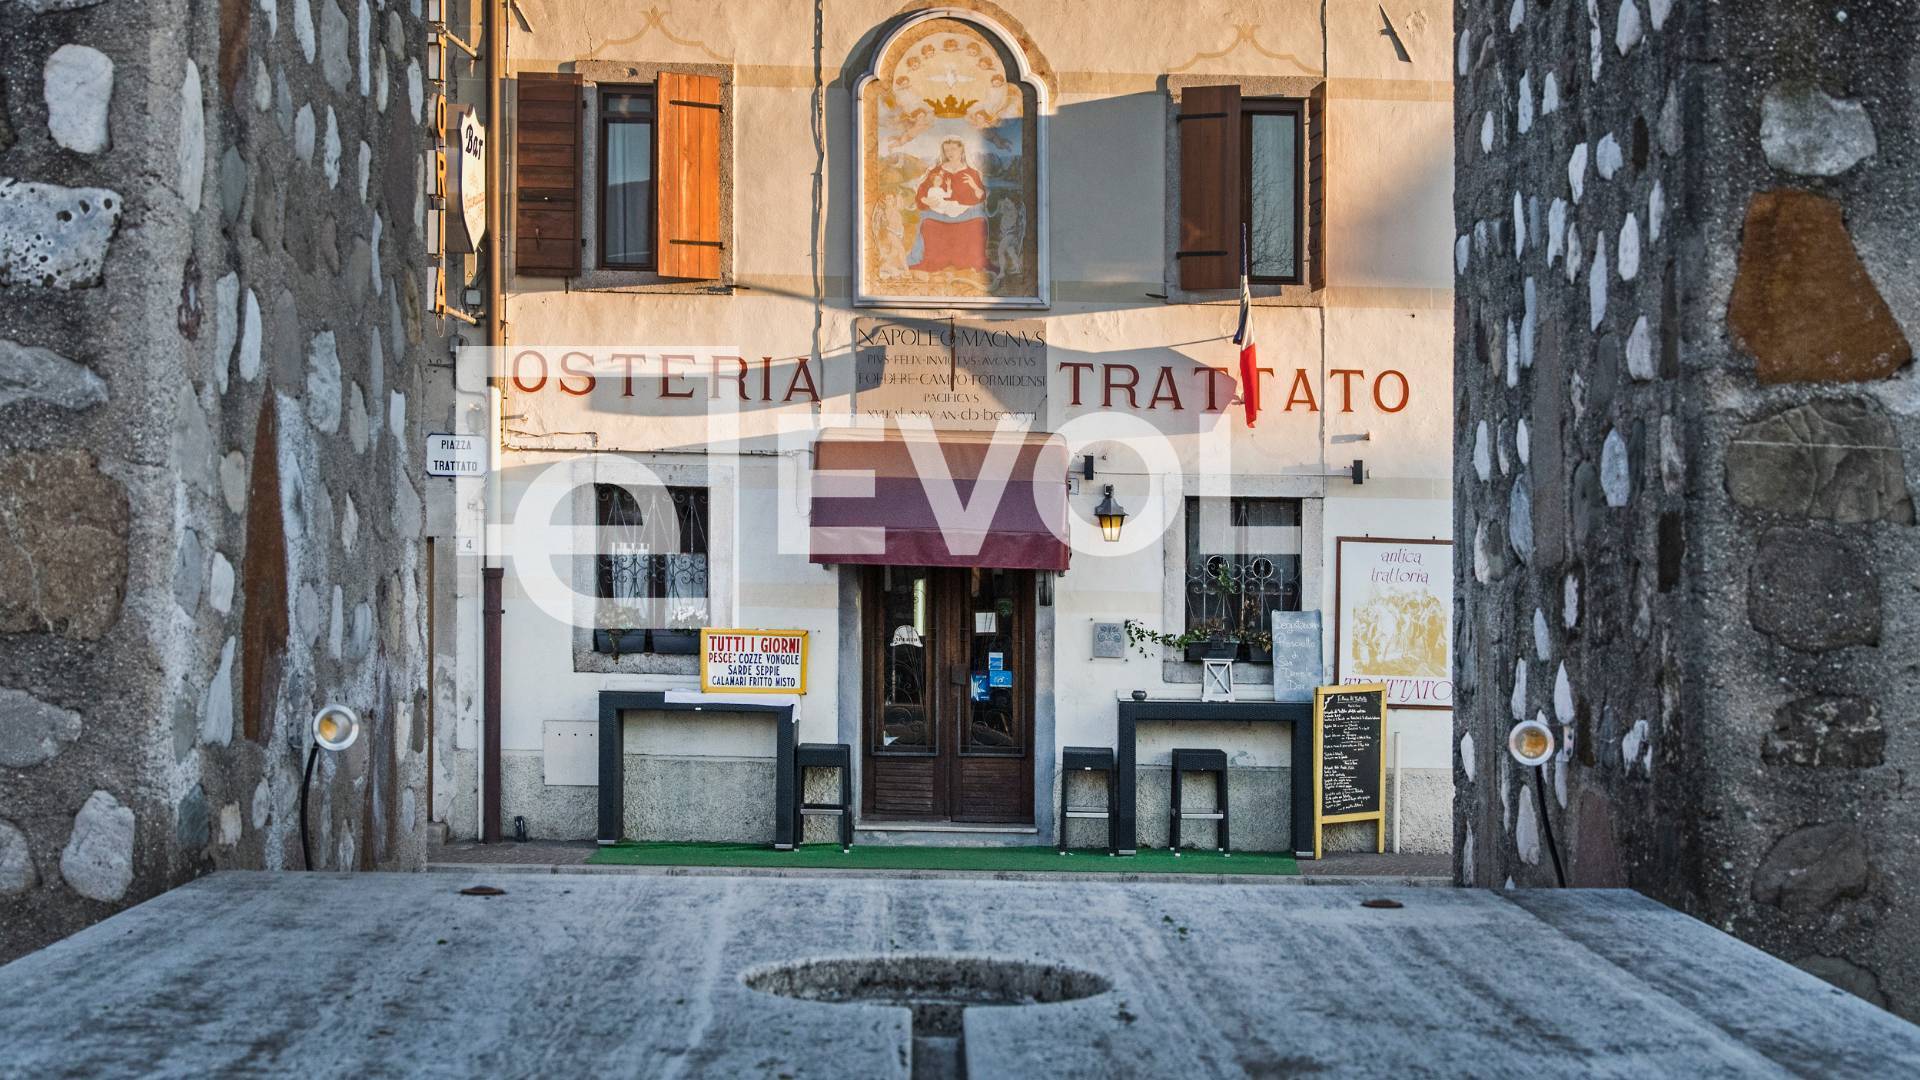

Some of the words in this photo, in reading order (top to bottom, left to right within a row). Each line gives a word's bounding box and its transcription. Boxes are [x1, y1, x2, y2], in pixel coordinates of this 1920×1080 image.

[466, 124, 484, 160] Bar
[512, 349, 822, 402] OSTERIA
[441, 439, 472, 450] PIAZZA
[433, 459, 478, 472] TRATTATO
[466, 539, 472, 549] 4
[1381, 548, 1423, 565] antica
[1371, 567, 1431, 585] trattoria
[708, 635, 745, 652] TUTTI
[751, 637, 755, 653] I
[760, 637, 801, 654] GIORNI
[708, 652, 736, 663] PESCE:
[738, 653, 763, 665] COZZE
[766, 654, 800, 665] VONGOLE
[728, 665, 752, 676] SARDE
[756, 665, 781, 676] SEPPIE
[711, 676, 747, 686] CALAMARI
[749, 676, 773, 687] FRITTO
[775, 677, 796, 687] MISTO
